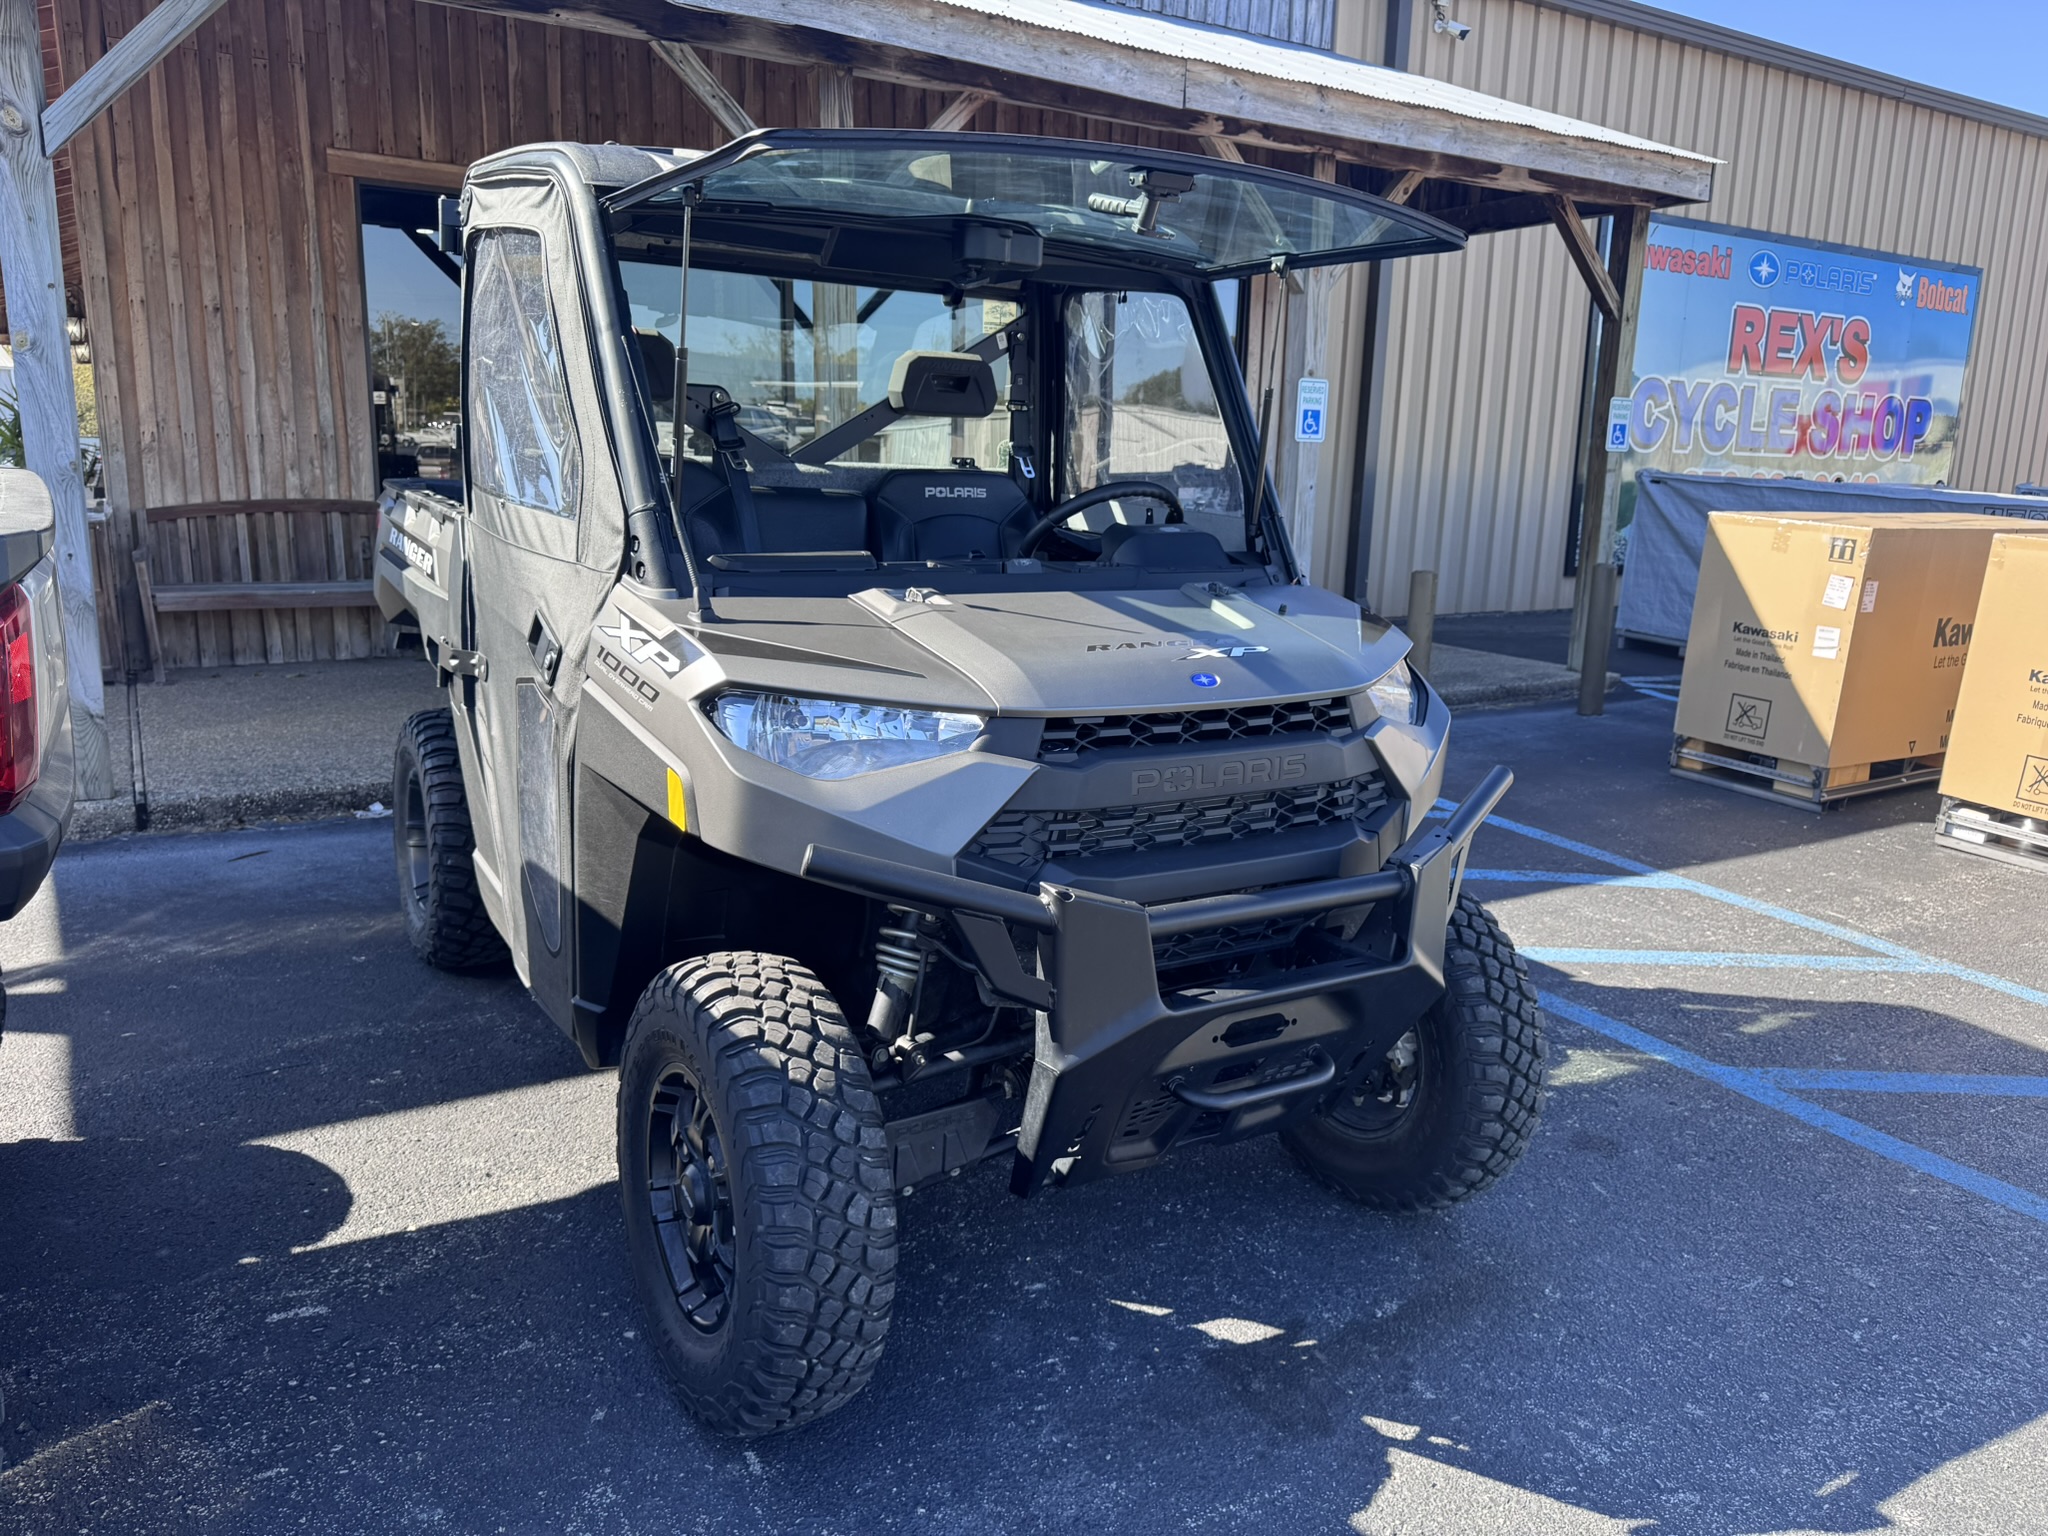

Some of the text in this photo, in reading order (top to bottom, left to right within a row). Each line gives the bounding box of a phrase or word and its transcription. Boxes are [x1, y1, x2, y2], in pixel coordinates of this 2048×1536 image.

[1643, 244, 1733, 280] wasaki
[1784, 260, 1876, 296] POLARIS
[1916, 275, 1968, 315] Bobcat
[1725, 301, 1871, 386] REX'S
[1629, 376, 1933, 463] CYCLE SHOP
[924, 486, 987, 498] POLARIS
[388, 526, 434, 577] RANGER
[600, 612, 681, 674] XP
[1733, 621, 1799, 643] Kawasaki
[1174, 645, 1271, 661] XP
[1736, 647, 1785, 665] Made in Thailand
[1933, 655, 1946, 669] Let
[1946, 653, 1960, 668] the
[594, 659, 608, 676] DUAL
[596, 645, 660, 703] 1000
[1724, 659, 1751, 673] Fabrique
[1751, 665, 1760, 674] en
[2030, 685, 2041, 694] Let
[2016, 713, 2048, 729] Fabriqu
[1131, 753, 1307, 797] POLARIS
[2013, 800, 2021, 808] DO
[2021, 803, 2032, 811] NOT
[2032, 805, 2044, 814] LIFT
